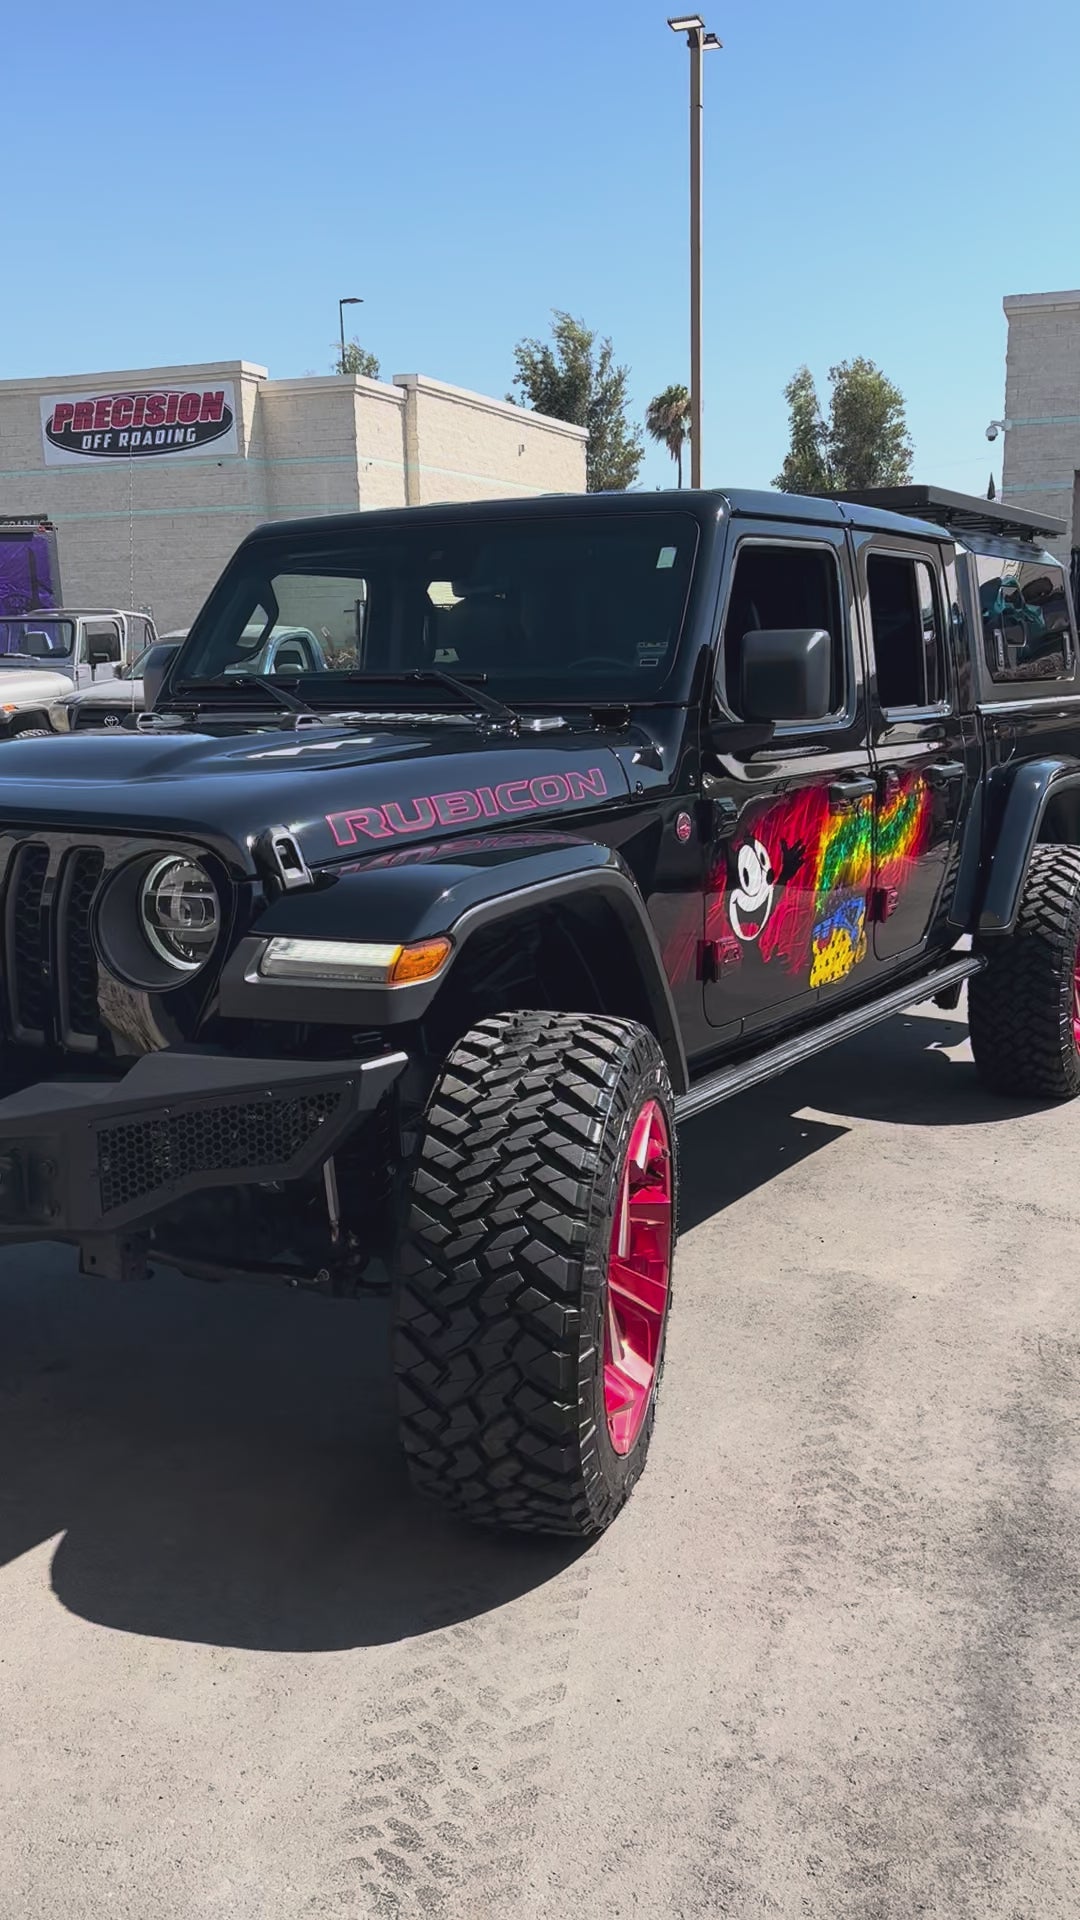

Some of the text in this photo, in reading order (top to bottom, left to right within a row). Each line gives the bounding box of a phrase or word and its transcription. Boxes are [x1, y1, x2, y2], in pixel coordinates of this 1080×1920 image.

[52, 391, 225, 433] PRECISION
[82, 427, 197, 449] OFF ROADING
[325, 767, 608, 846] RUBICON
